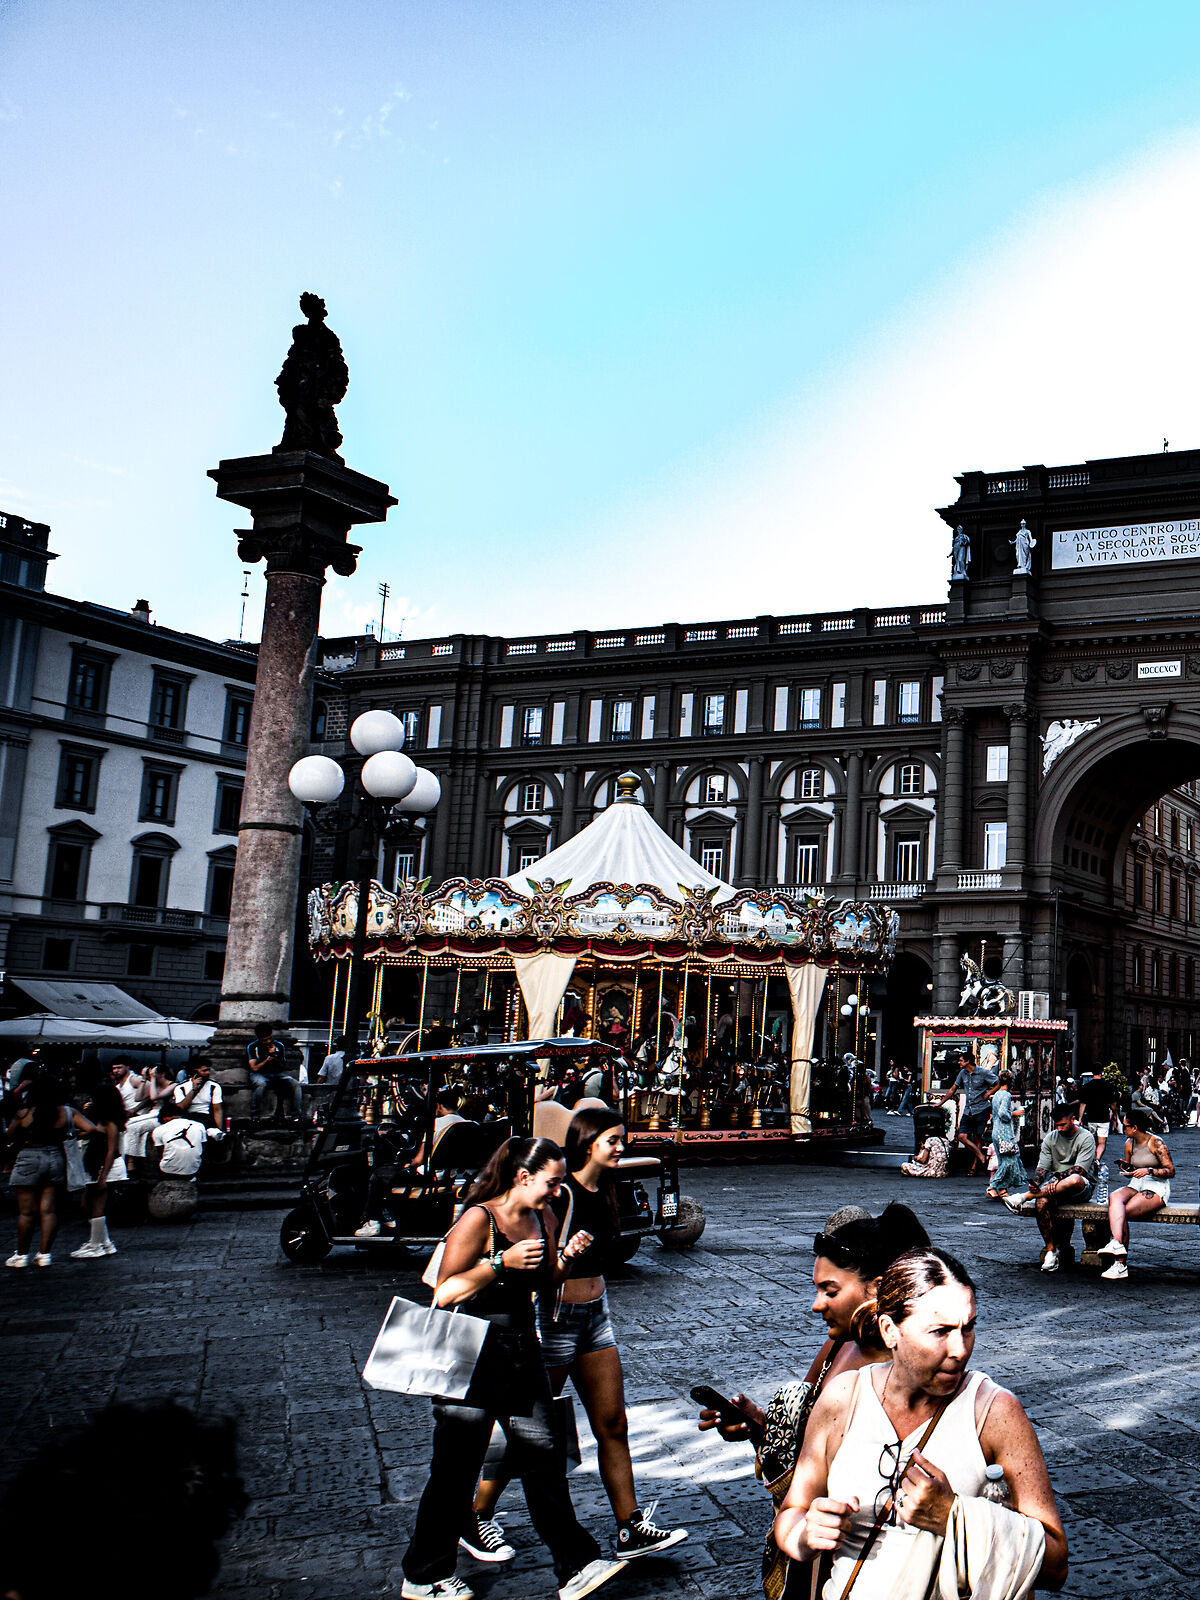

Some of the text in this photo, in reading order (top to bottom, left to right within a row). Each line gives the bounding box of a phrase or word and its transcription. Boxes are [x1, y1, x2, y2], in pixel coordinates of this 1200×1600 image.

[1072, 529, 1118, 542] ANTICO
[1122, 524, 1174, 537] CENTRO
[1076, 542, 1093, 552] DA
[1097, 536, 1165, 550] SECOLARE
[1076, 554, 1084, 563] A
[1090, 551, 1118, 562] VITA
[1123, 547, 1166, 559] NUOVA
[1139, 665, 1179, 675] MDCCCXCV
[534, 1048, 553, 1056] BOOK
[555, 1047, 571, 1056] NOW
